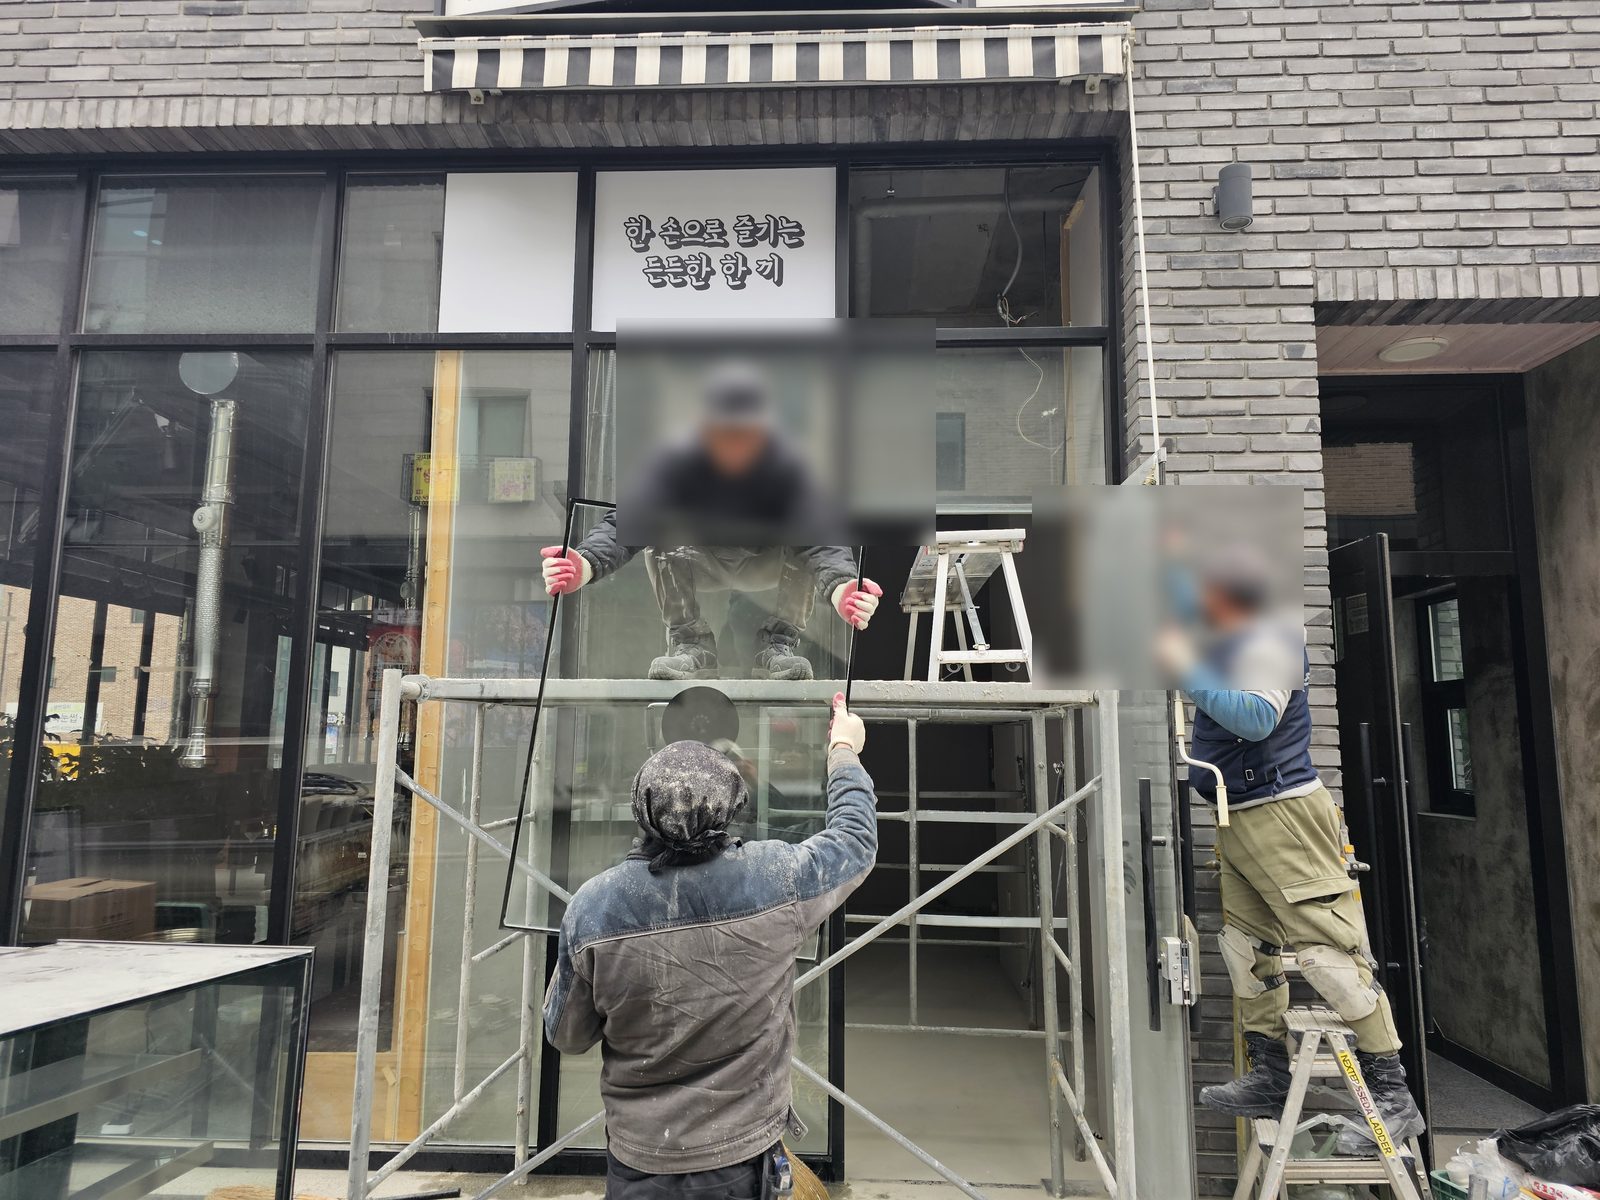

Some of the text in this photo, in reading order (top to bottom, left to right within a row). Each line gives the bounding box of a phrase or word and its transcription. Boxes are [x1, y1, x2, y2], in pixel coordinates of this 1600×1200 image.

[624, 214, 806, 253] 한 손으로 즐기는
[642, 251, 785, 291] 든든한 한 끼
[1368, 1114, 1393, 1154] LADDER
